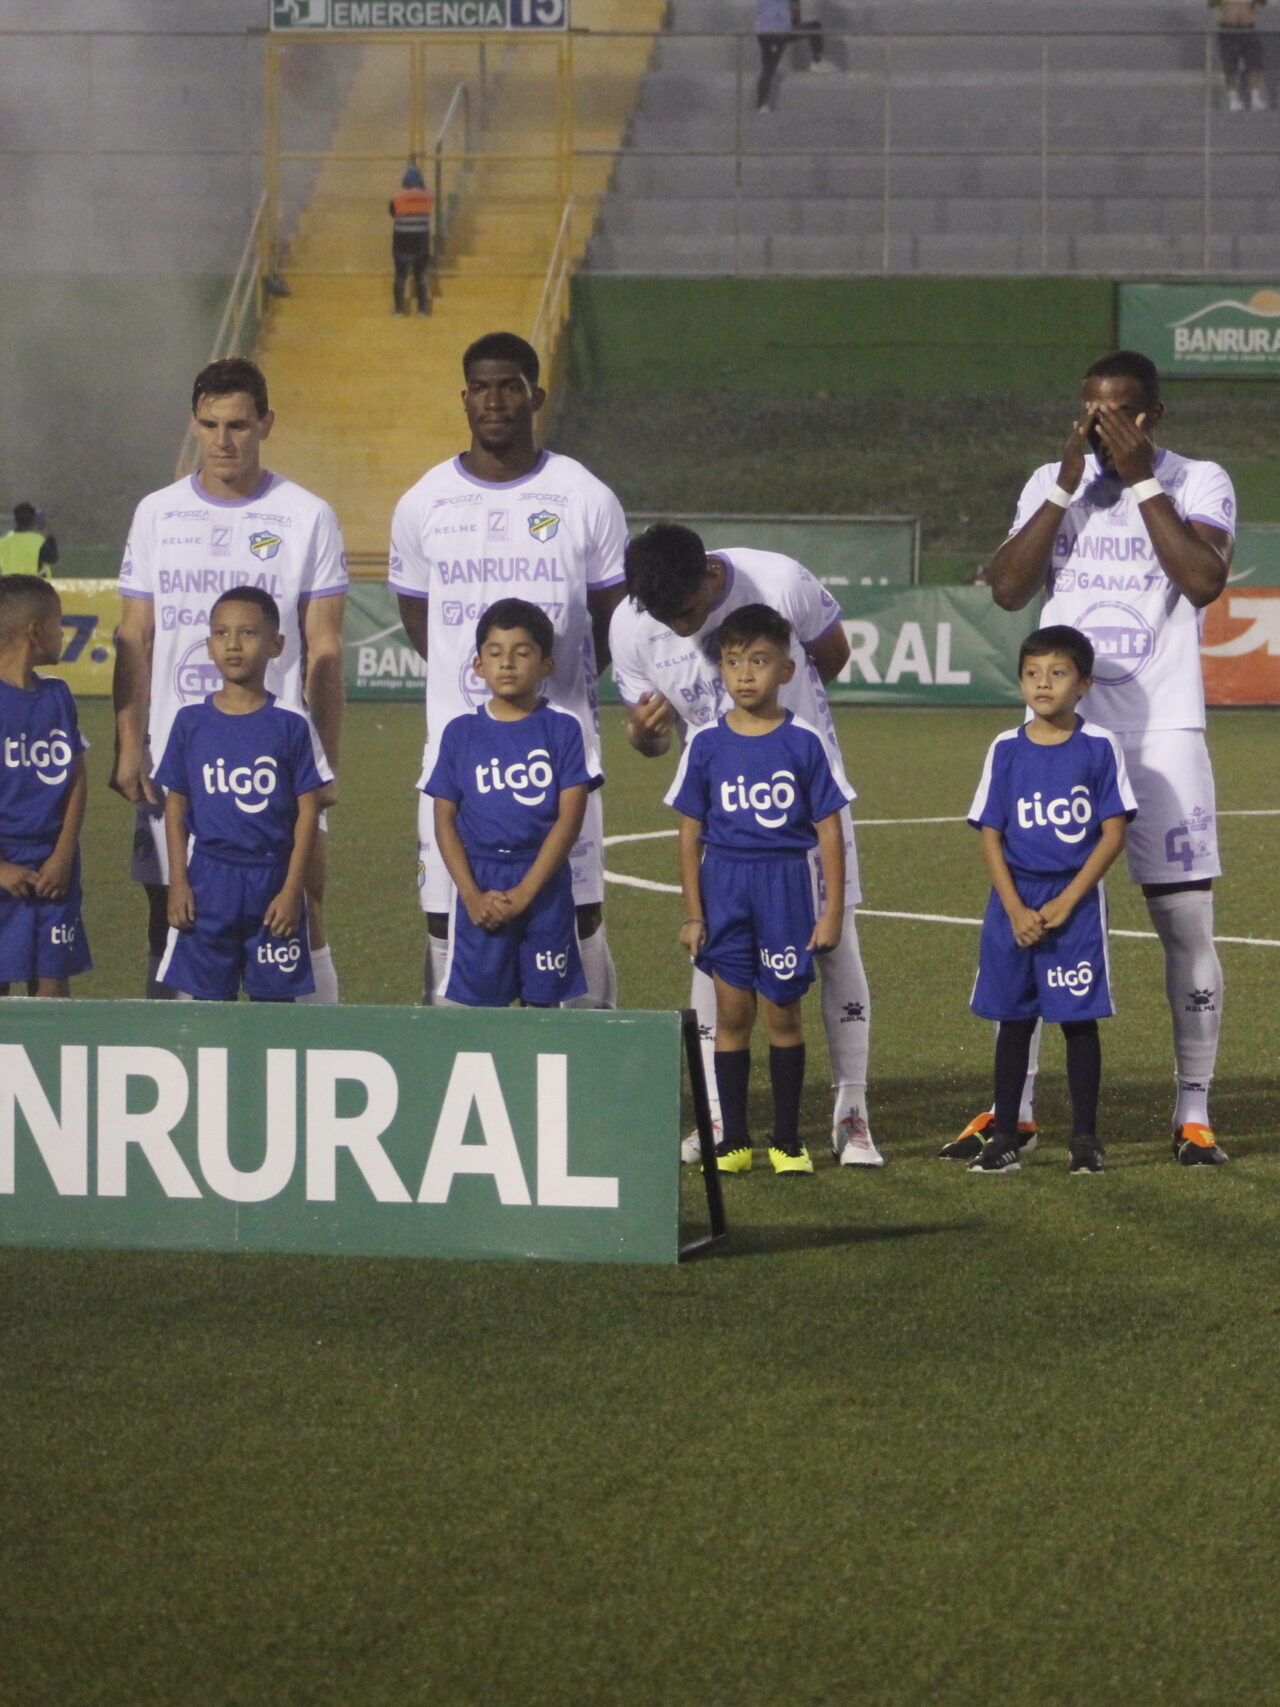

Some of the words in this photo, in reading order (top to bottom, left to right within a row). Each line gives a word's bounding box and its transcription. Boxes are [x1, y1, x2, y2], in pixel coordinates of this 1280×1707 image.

[333, 2, 502, 27] EMERGENCIA
[435, 524, 477, 535] KELME
[490, 511, 504, 531] Z
[213, 528, 228, 547] Z
[437, 557, 564, 585] BANRURAL
[656, 652, 697, 669] KELME
[369, 680, 402, 690] amigo
[4, 729, 72, 769] tigo
[203, 756, 277, 796] tigo
[475, 749, 553, 793] tigo
[720, 770, 795, 812] tigo
[1017, 785, 1092, 829] tigo
[1164, 826, 1195, 872] 4
[257, 938, 301, 965] tigo
[760, 945, 797, 970] tigo
[1048, 961, 1093, 988] tigo
